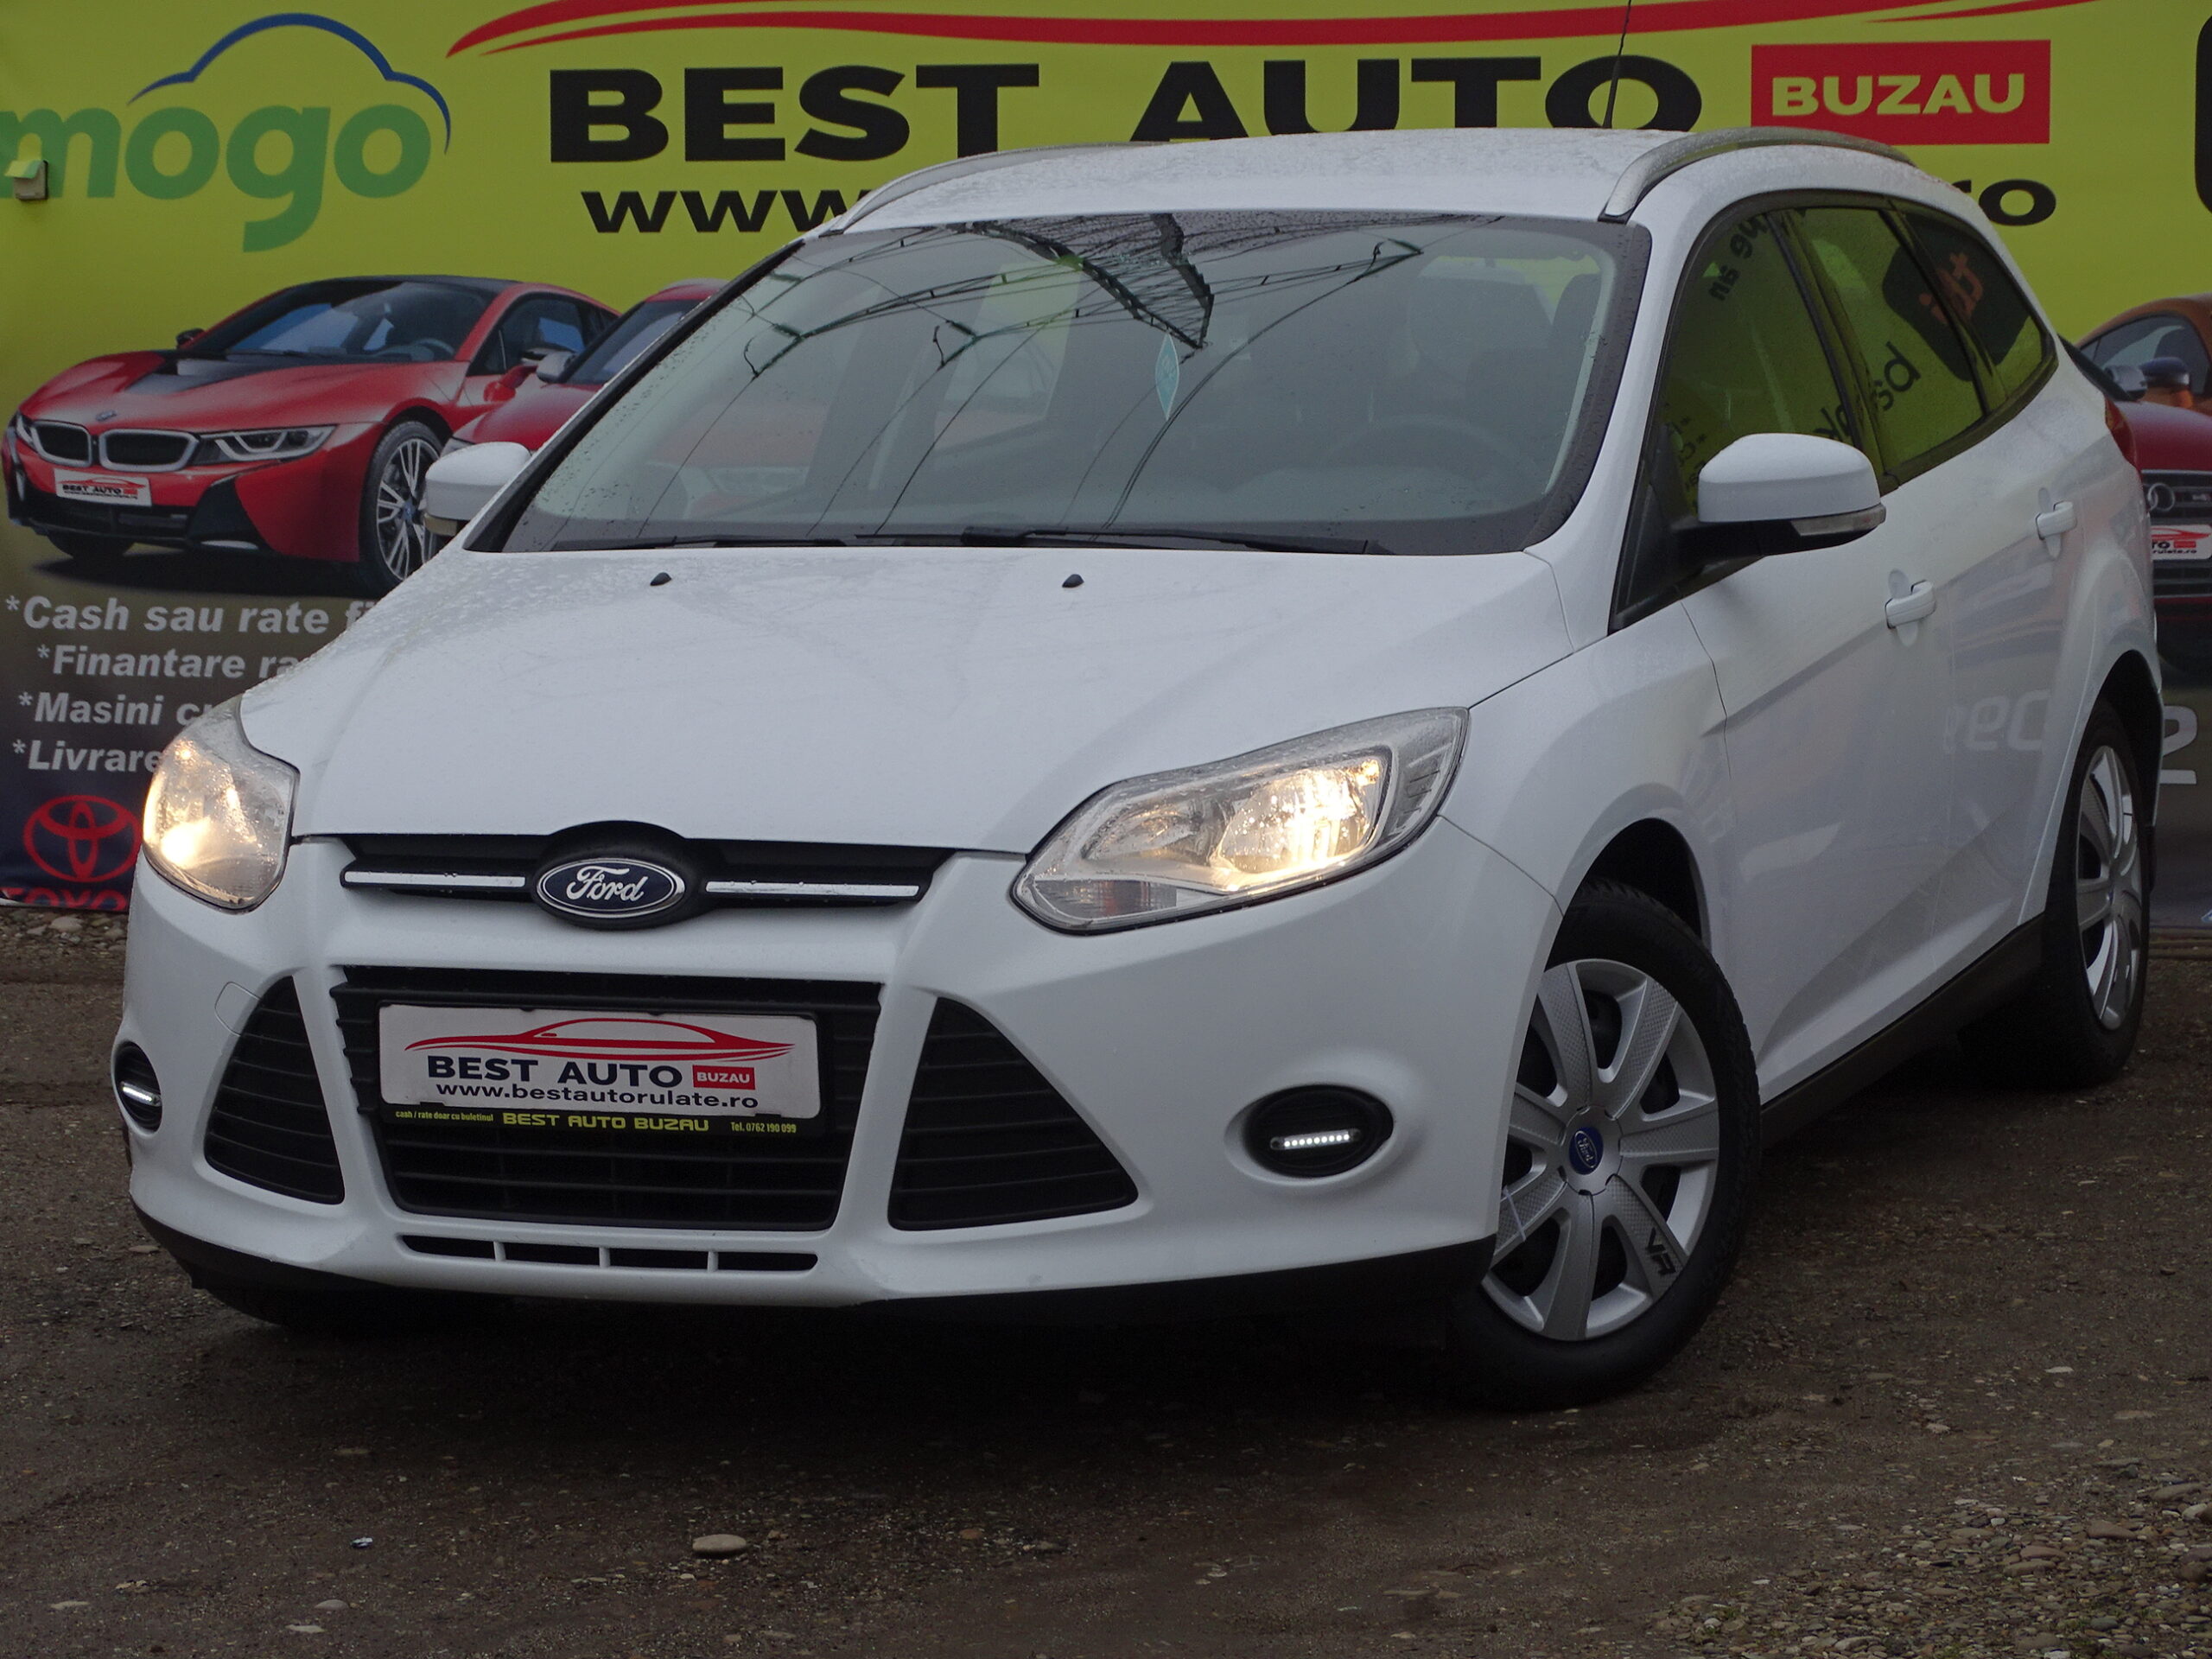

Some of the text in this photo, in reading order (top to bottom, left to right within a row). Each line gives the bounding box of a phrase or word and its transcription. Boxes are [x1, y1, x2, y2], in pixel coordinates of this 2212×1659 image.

[550, 54, 1701, 162] BEST AUTO
[1772, 73, 2024, 116] BUZAU
[0, 104, 431, 253] mogo
[144, 606, 224, 632] sau
[238, 603, 329, 633] rate
[566, 865, 649, 901] Ford
[427, 1054, 751, 1087] BEST AUTO BUZAU
[435, 1082, 758, 1109] www.bestautorulate.ro
[417, 1111, 433, 1120] rate
[433, 1111, 450, 1120] doar
[451, 1112, 460, 1121] cu
[461, 1111, 493, 1122] buletinul
[503, 1112, 559, 1126] BEST
[568, 1115, 626, 1128] AUTO
[634, 1116, 709, 1132] BUZAU
[730, 1122, 745, 1132] Tel.
[746, 1122, 766, 1133] 0762
[766, 1122, 780, 1133] 190
